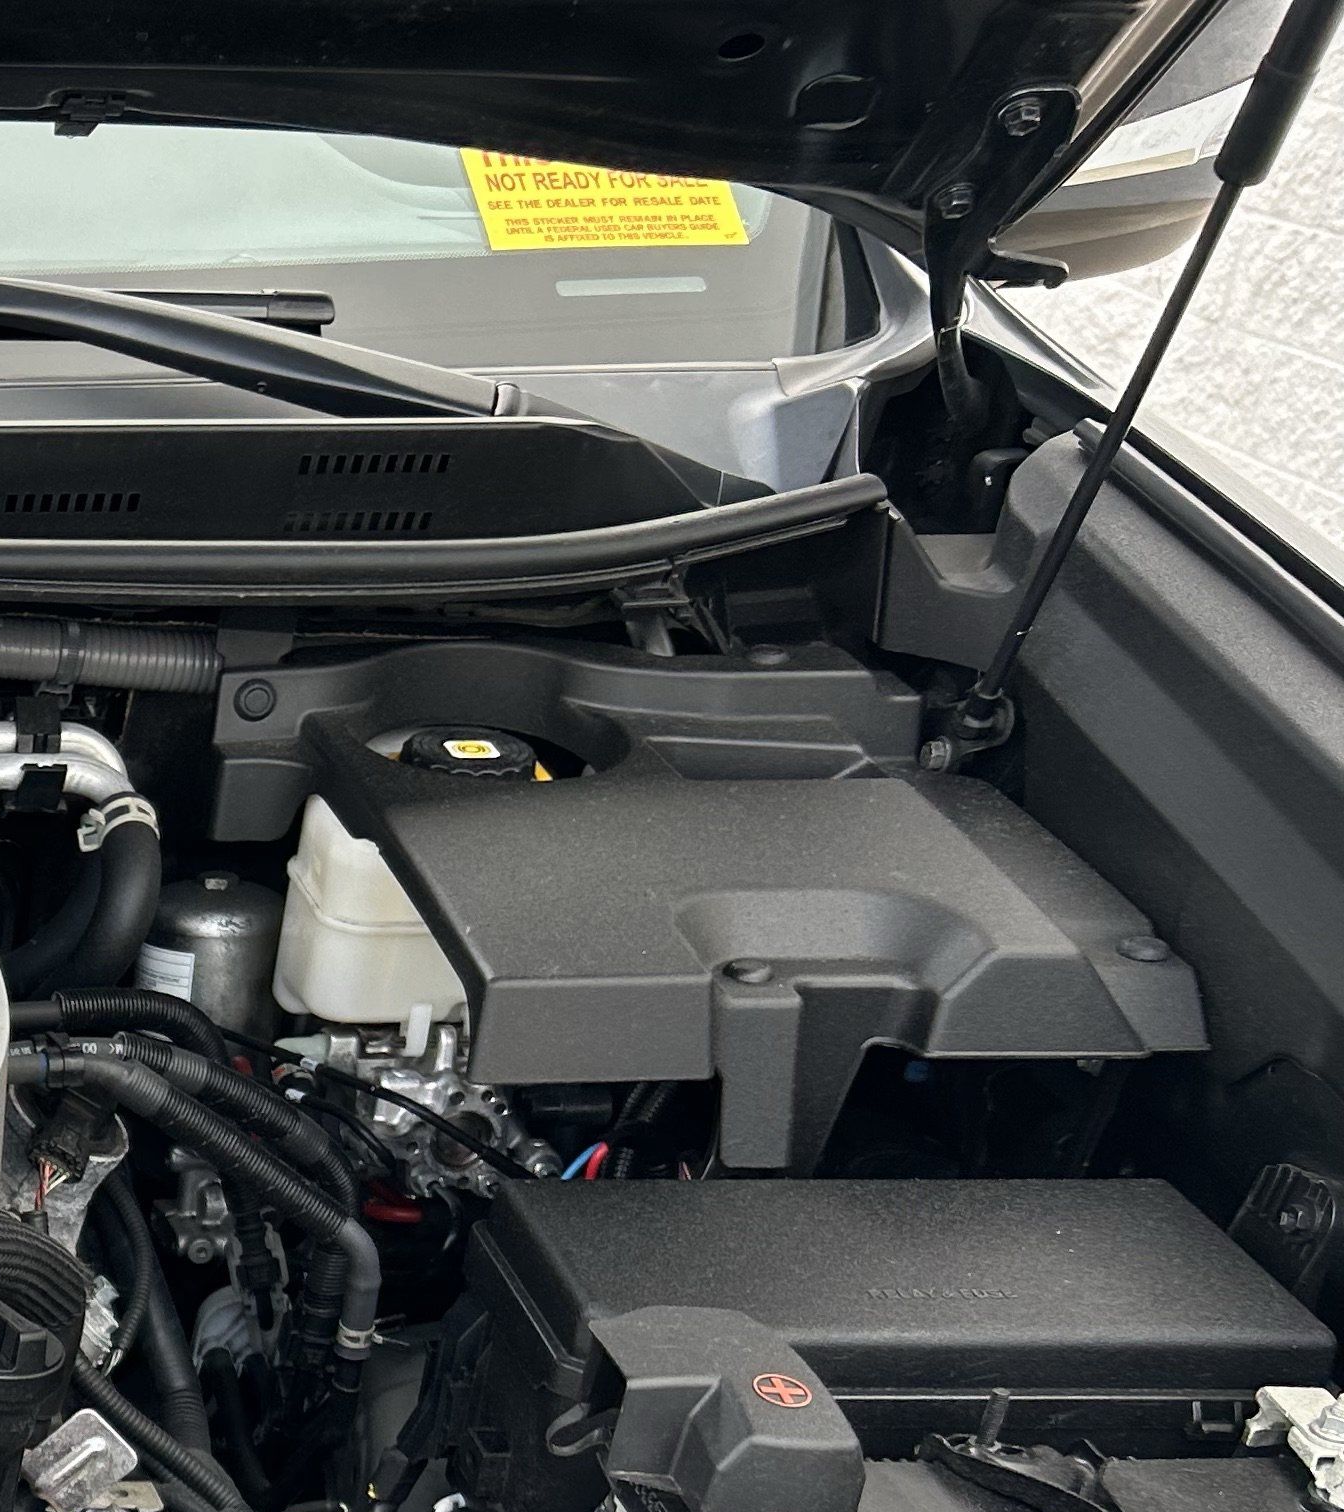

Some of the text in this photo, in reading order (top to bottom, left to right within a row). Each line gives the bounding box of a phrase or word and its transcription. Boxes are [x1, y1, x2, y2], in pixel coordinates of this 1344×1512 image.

[484, 173, 526, 192] NOT
[532, 172, 600, 191] READY
[608, 171, 652, 188] FOR
[488, 196, 721, 210] SEE THE DEALER FOR RESALE DATE
[505, 218, 529, 226] THIS
[534, 217, 578, 225] STICKER
[583, 216, 614, 224] MUST
[619, 215, 662, 223] REMAIN
[506, 227, 533, 235] UNTIL
[547, 226, 592, 234] FEDERAL
[594, 224, 621, 232] USED
[647, 223, 687, 231] BUYERS
[558, 233, 599, 241] AFFIXED
[618, 232, 640, 240] THIS
